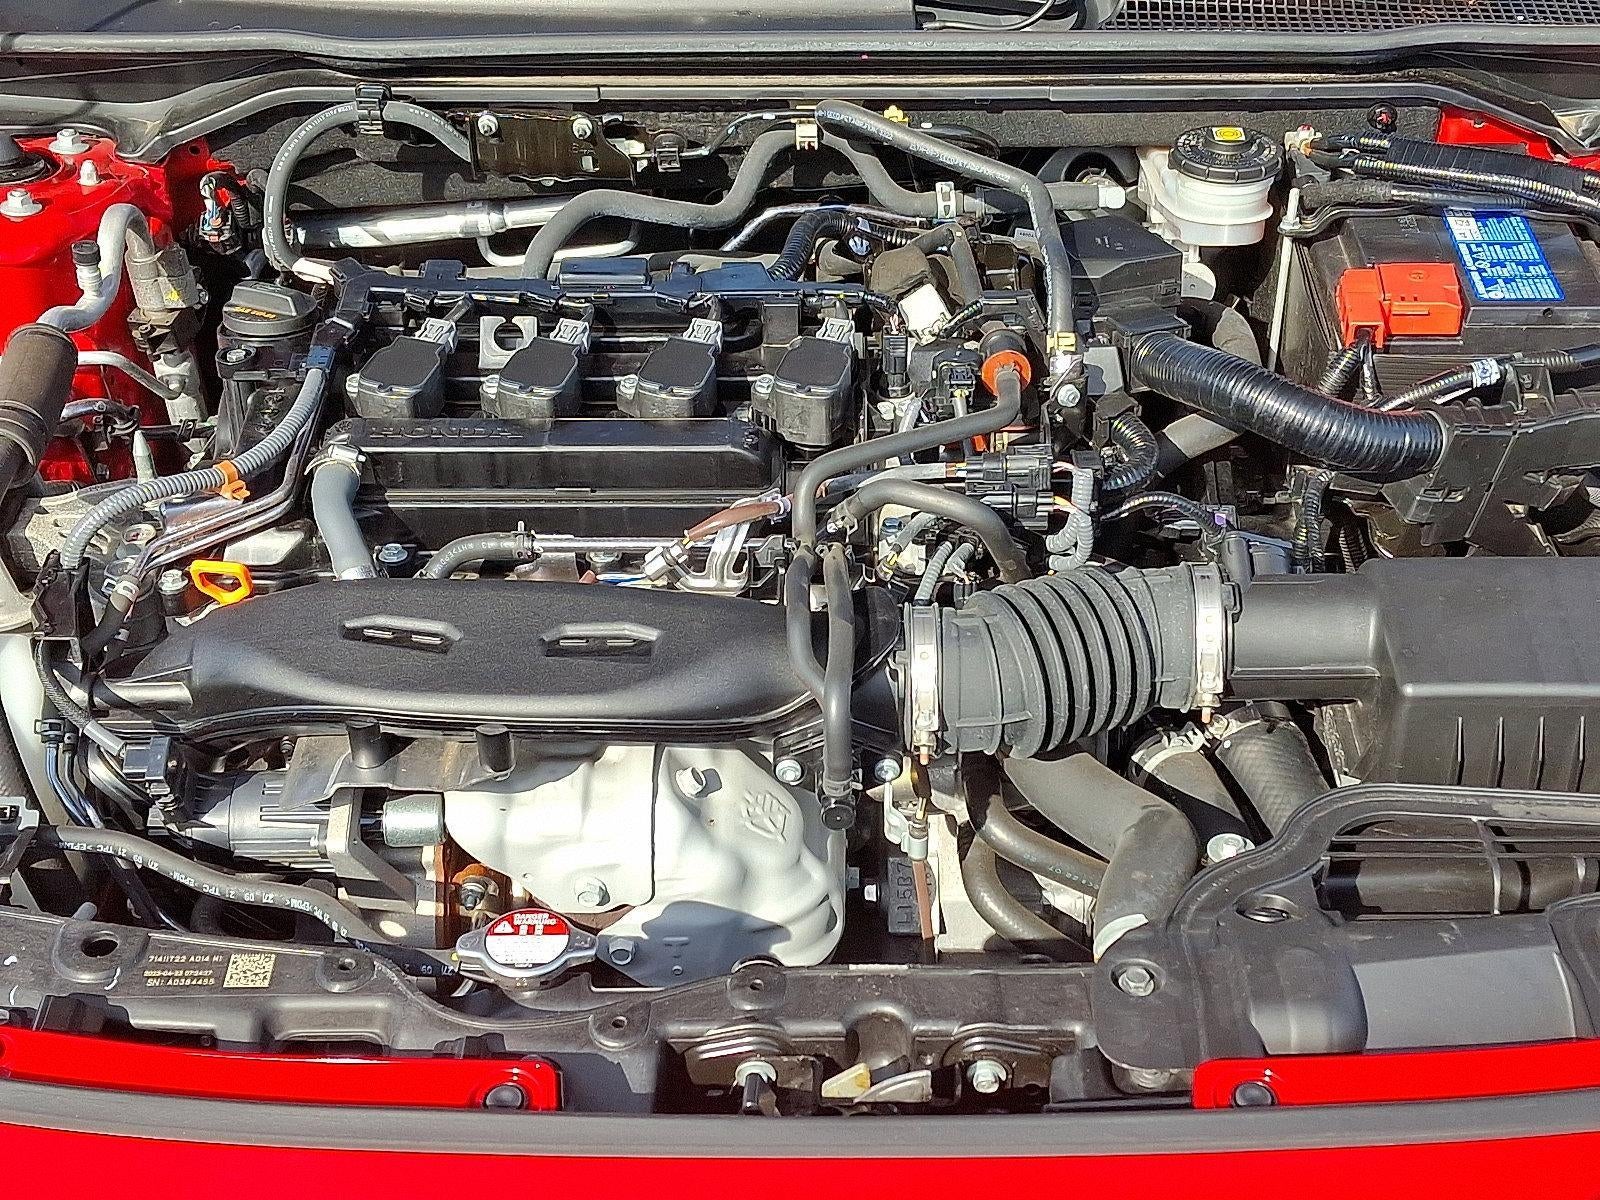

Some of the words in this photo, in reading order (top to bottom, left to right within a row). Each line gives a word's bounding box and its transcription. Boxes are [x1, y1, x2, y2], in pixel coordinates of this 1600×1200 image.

[369, 426, 524, 439] HONDA
[96, 844, 114, 855] TPC
[118, 847, 127, 857] 21
[202, 884, 221, 896] TPC
[226, 888, 236, 899] 21
[897, 863, 913, 924] L15B7
[244, 892, 255, 902] 09
[514, 913, 549, 921] DANGER
[514, 918, 557, 926] WARNING
